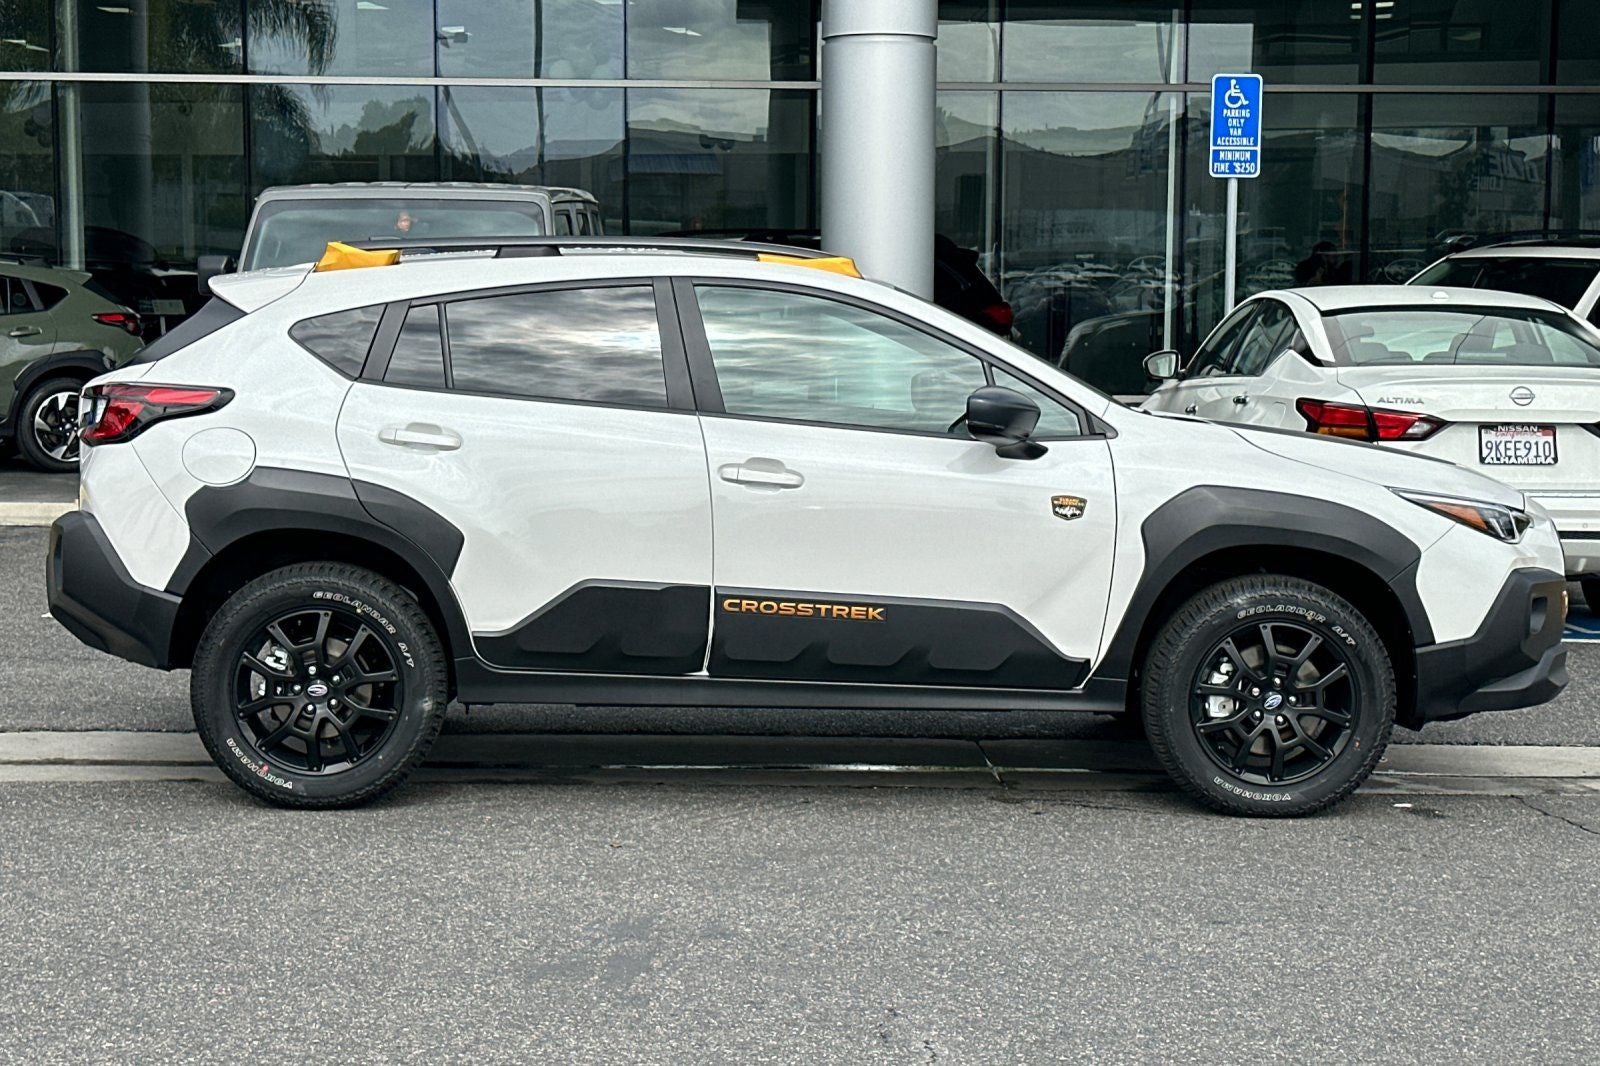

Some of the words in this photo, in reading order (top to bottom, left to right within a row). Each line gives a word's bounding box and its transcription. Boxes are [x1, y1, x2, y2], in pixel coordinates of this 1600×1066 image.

[1223, 109, 1250, 117] PARKING
[1228, 118, 1245, 127] ONLY
[1229, 128, 1242, 136] VAN
[1217, 137, 1254, 146] ACCESSIBLE
[1220, 151, 1251, 161] MINIMUM
[1213, 162, 1230, 173] FINE
[1233, 162, 1255, 173] $250
[1377, 397, 1425, 405] ALTIMA
[1485, 440, 1552, 459] 9KEE910
[1484, 456, 1555, 464] ALHAMBRA
[723, 599, 885, 621] CROSSTREK
[313, 591, 397, 635] GEOLANDAR
[398, 642, 415, 668] A/T
[1237, 604, 1327, 623] GEOLANDAR
[1332, 625, 1357, 646] A/T
[226, 737, 293, 790] YOKOHAMA
[1213, 775, 1292, 802] YOKOHAMA
